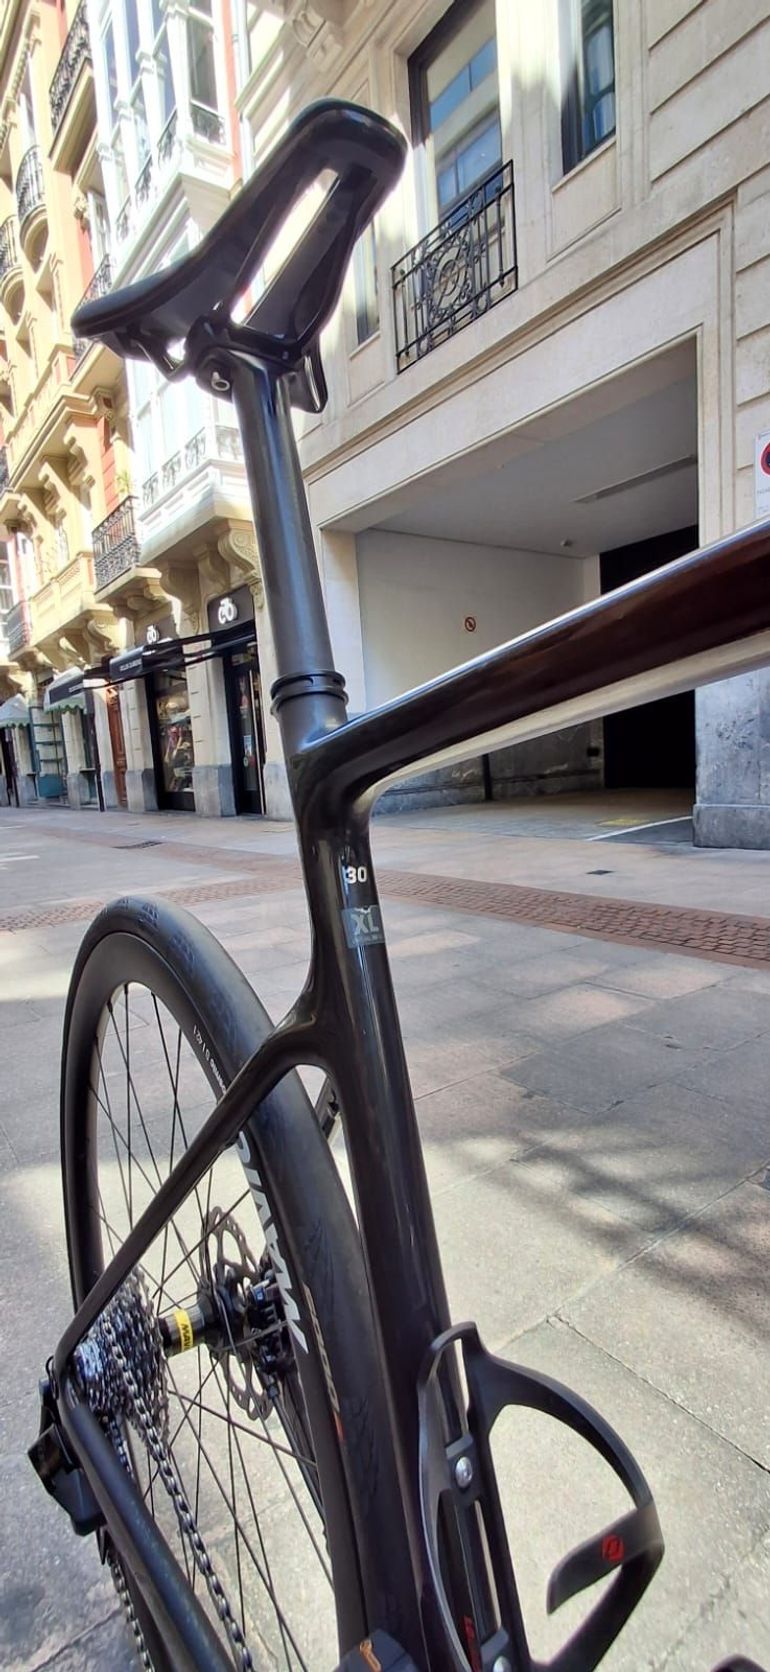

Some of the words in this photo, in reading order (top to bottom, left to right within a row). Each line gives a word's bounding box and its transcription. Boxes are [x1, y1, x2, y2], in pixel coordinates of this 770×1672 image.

[346, 866, 367, 884] 30
[350, 911, 380, 934] XL
[237, 1130, 309, 1354] MAVIC
[180, 1323, 193, 1349] MAV
